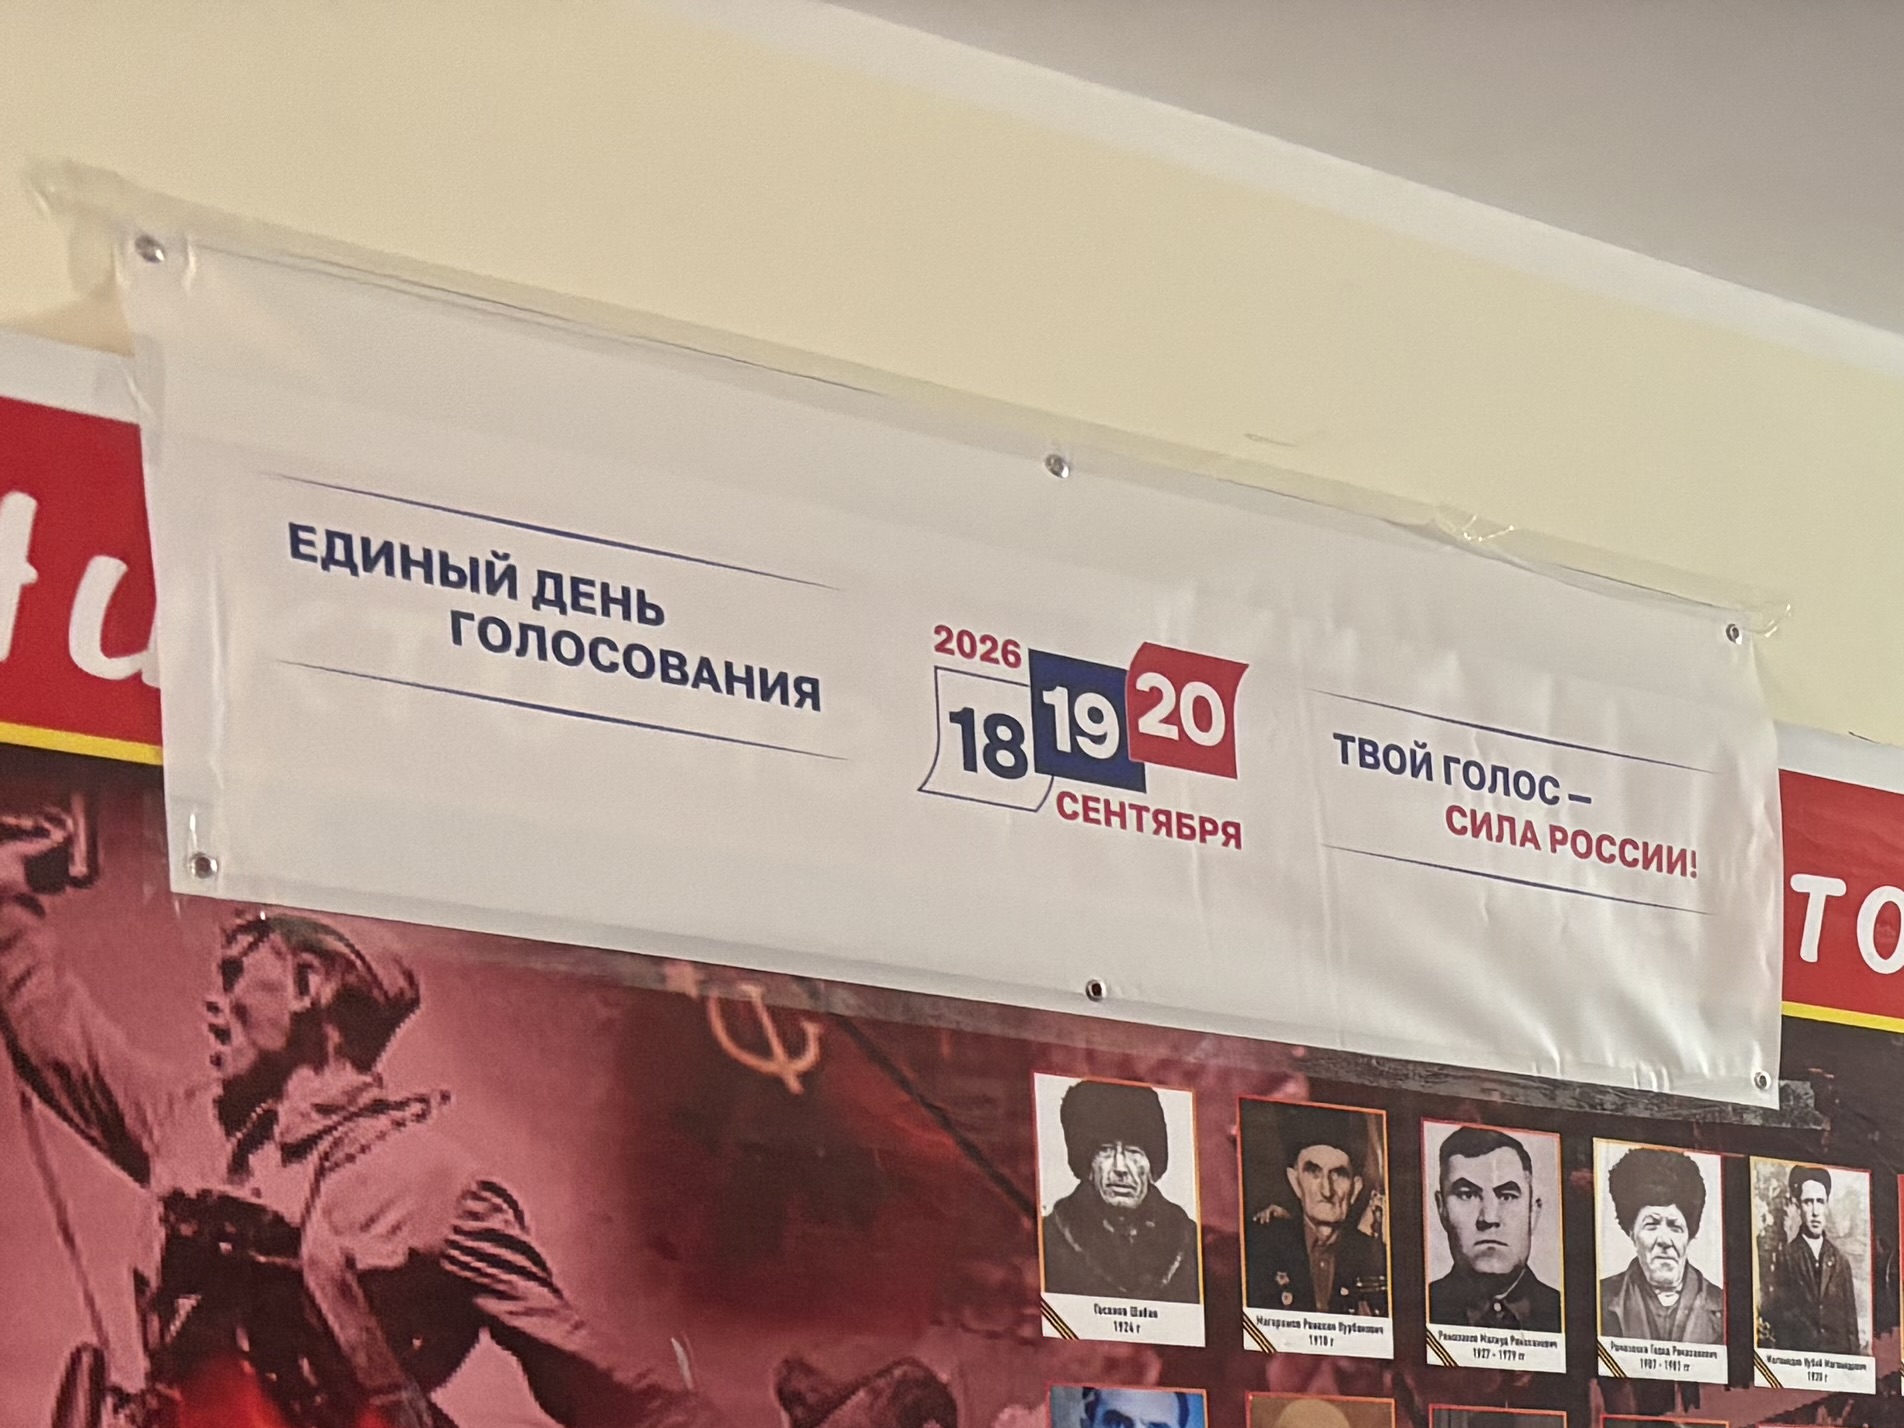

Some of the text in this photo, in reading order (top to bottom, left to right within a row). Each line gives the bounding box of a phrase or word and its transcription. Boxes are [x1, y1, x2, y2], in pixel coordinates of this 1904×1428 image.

[287, 520, 665, 631] ЕДИНЫЙ ДЕНЬ
[449, 608, 822, 714] ГОЛОСОВАНИЯ
[933, 624, 1022, 671] 2026
[948, 671, 1226, 780] 18 19 20
[1333, 732, 1433, 781] ТВОЙ
[1443, 755, 1560, 805] ГОЛОС
[1056, 790, 1243, 850] СЕНТЯБРЯ
[1446, 804, 1697, 879] СИЛА РОССИИ!
